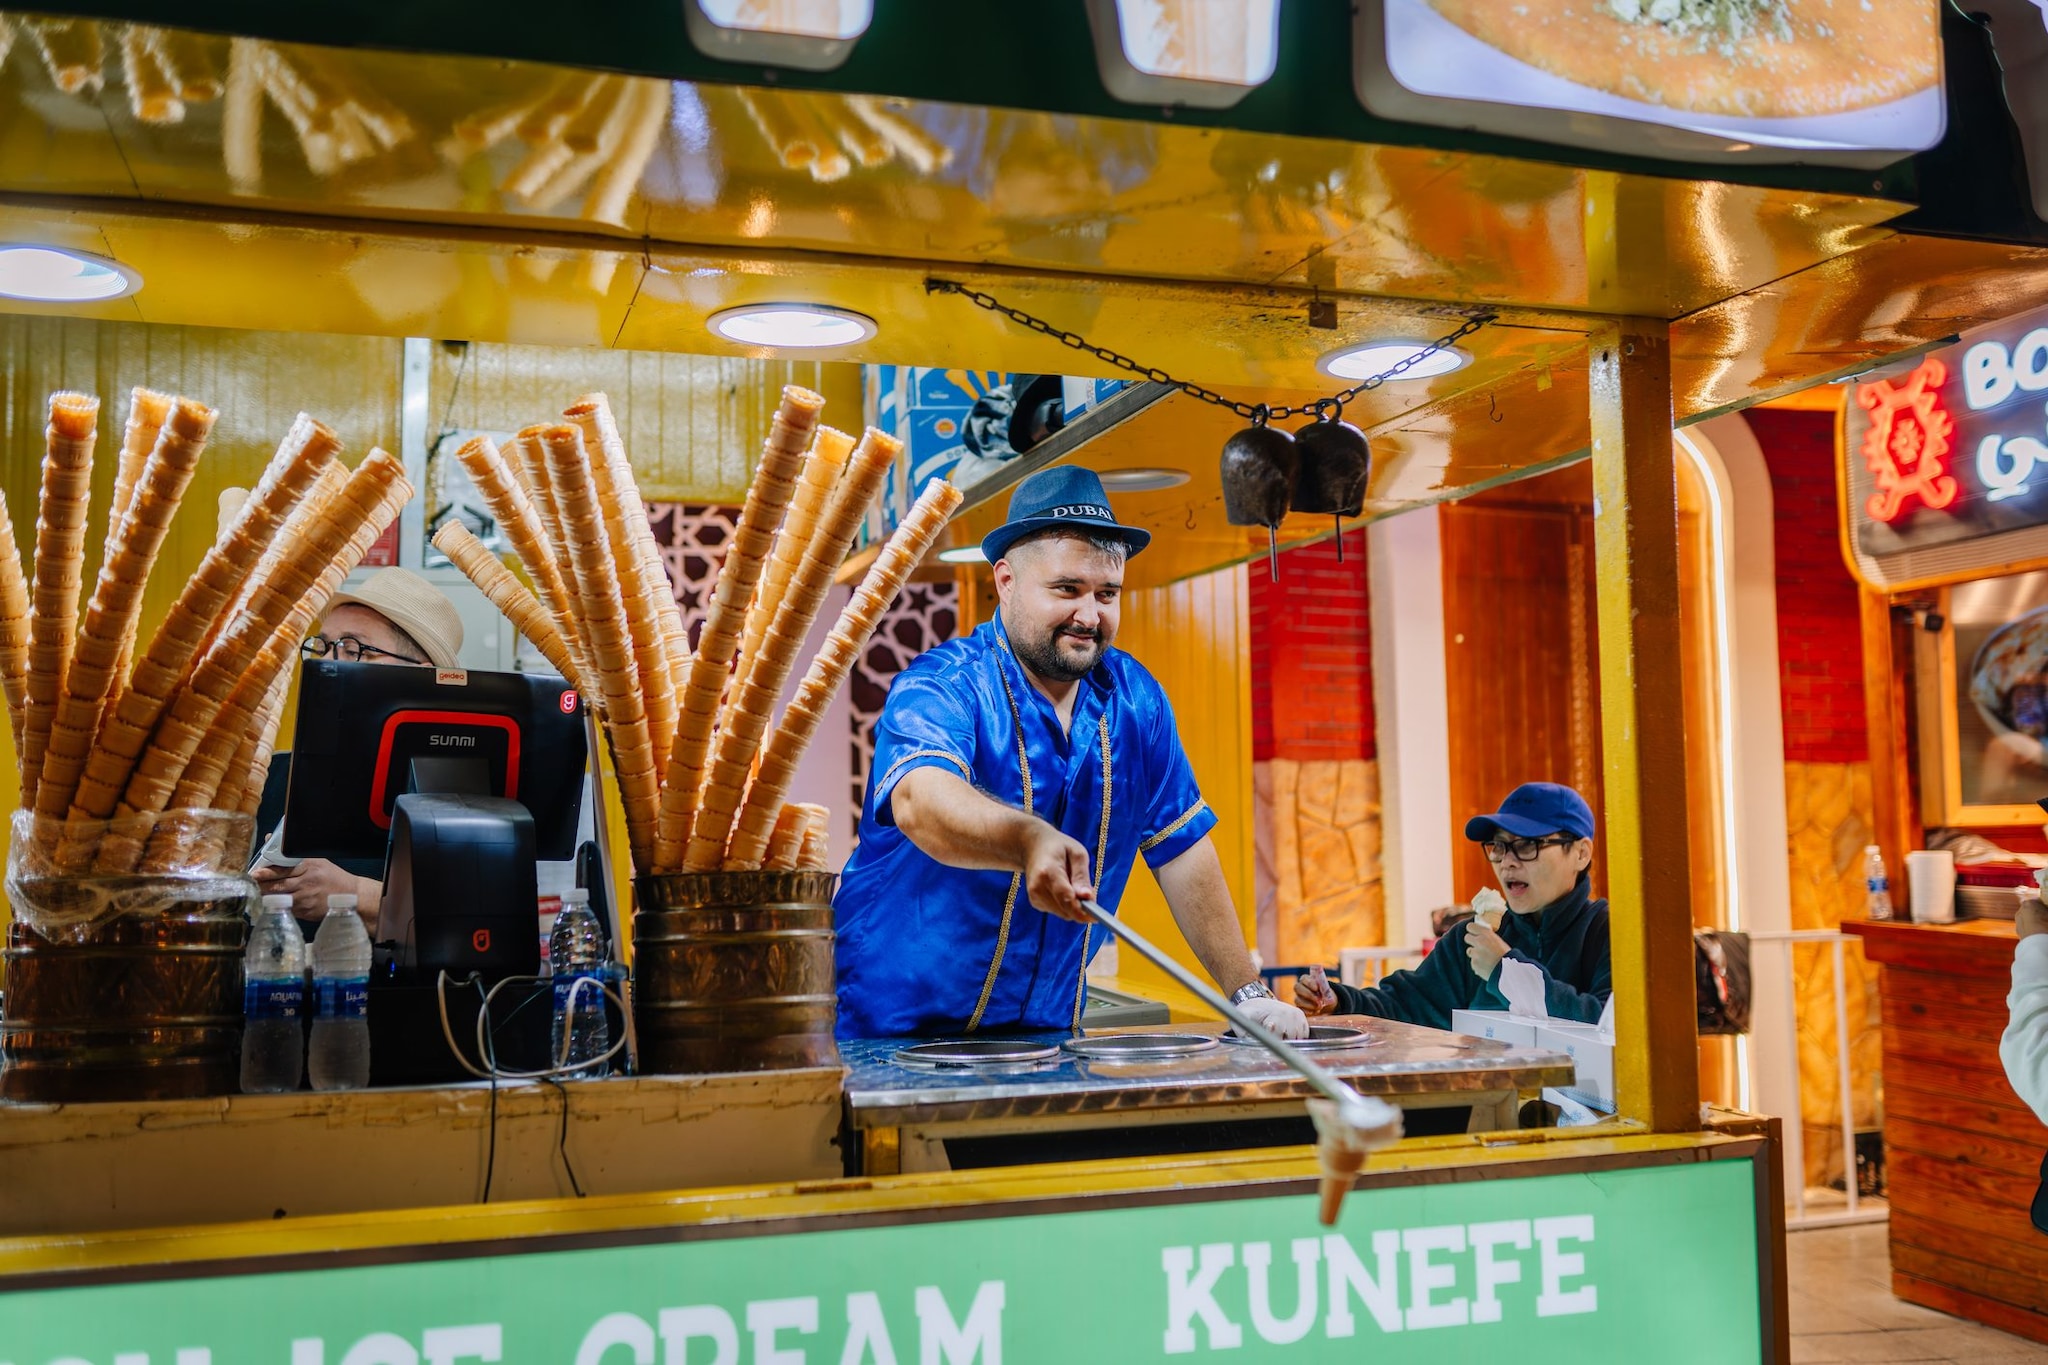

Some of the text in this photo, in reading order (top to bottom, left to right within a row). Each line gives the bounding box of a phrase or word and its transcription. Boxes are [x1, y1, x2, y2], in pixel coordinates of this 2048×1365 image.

[1052, 505, 1114, 521] DUBAI
[439, 672, 464, 680] geidea
[429, 734, 476, 747] SUNMI
[1161, 1214, 1598, 1354] KUNEFE
